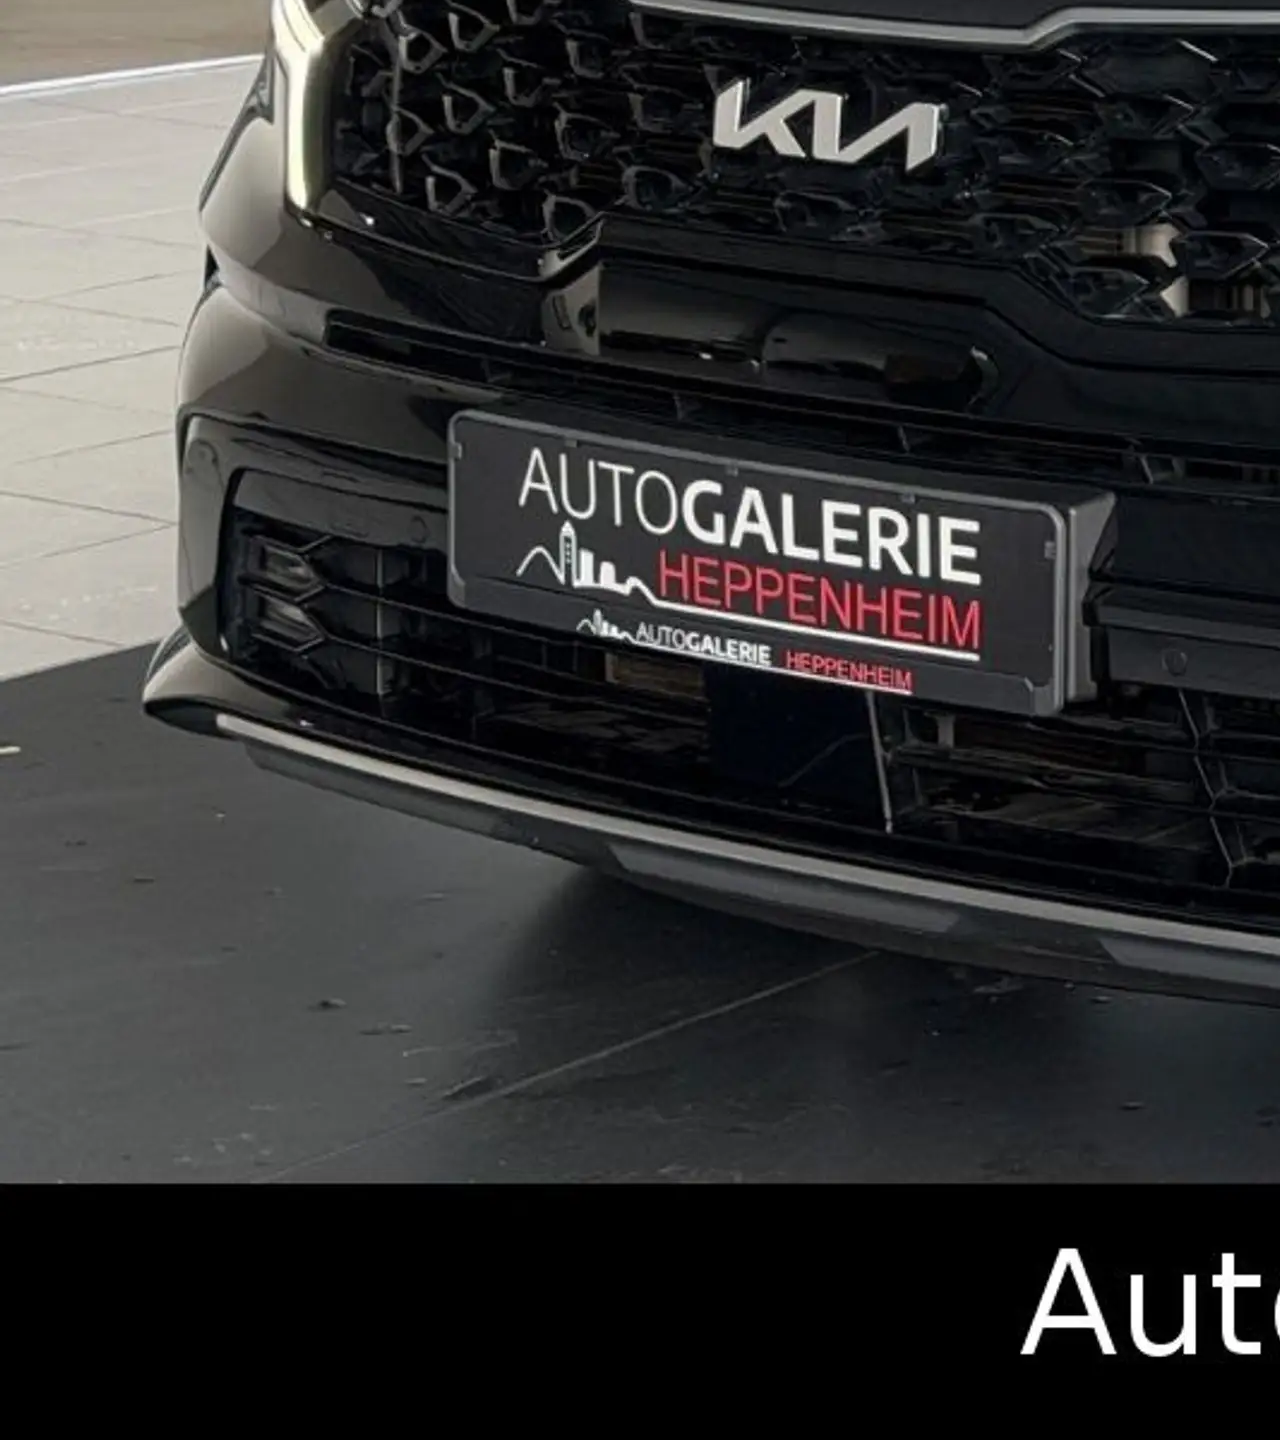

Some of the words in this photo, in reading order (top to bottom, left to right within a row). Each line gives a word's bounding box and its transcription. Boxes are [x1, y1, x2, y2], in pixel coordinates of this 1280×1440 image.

[713, 78, 940, 171] KIA
[518, 446, 982, 585] AUTOGALERIE
[658, 548, 982, 649] HEPPENHEIM
[634, 621, 771, 667] AUTOGALERIE
[786, 649, 913, 691] HEPPENHEIM
